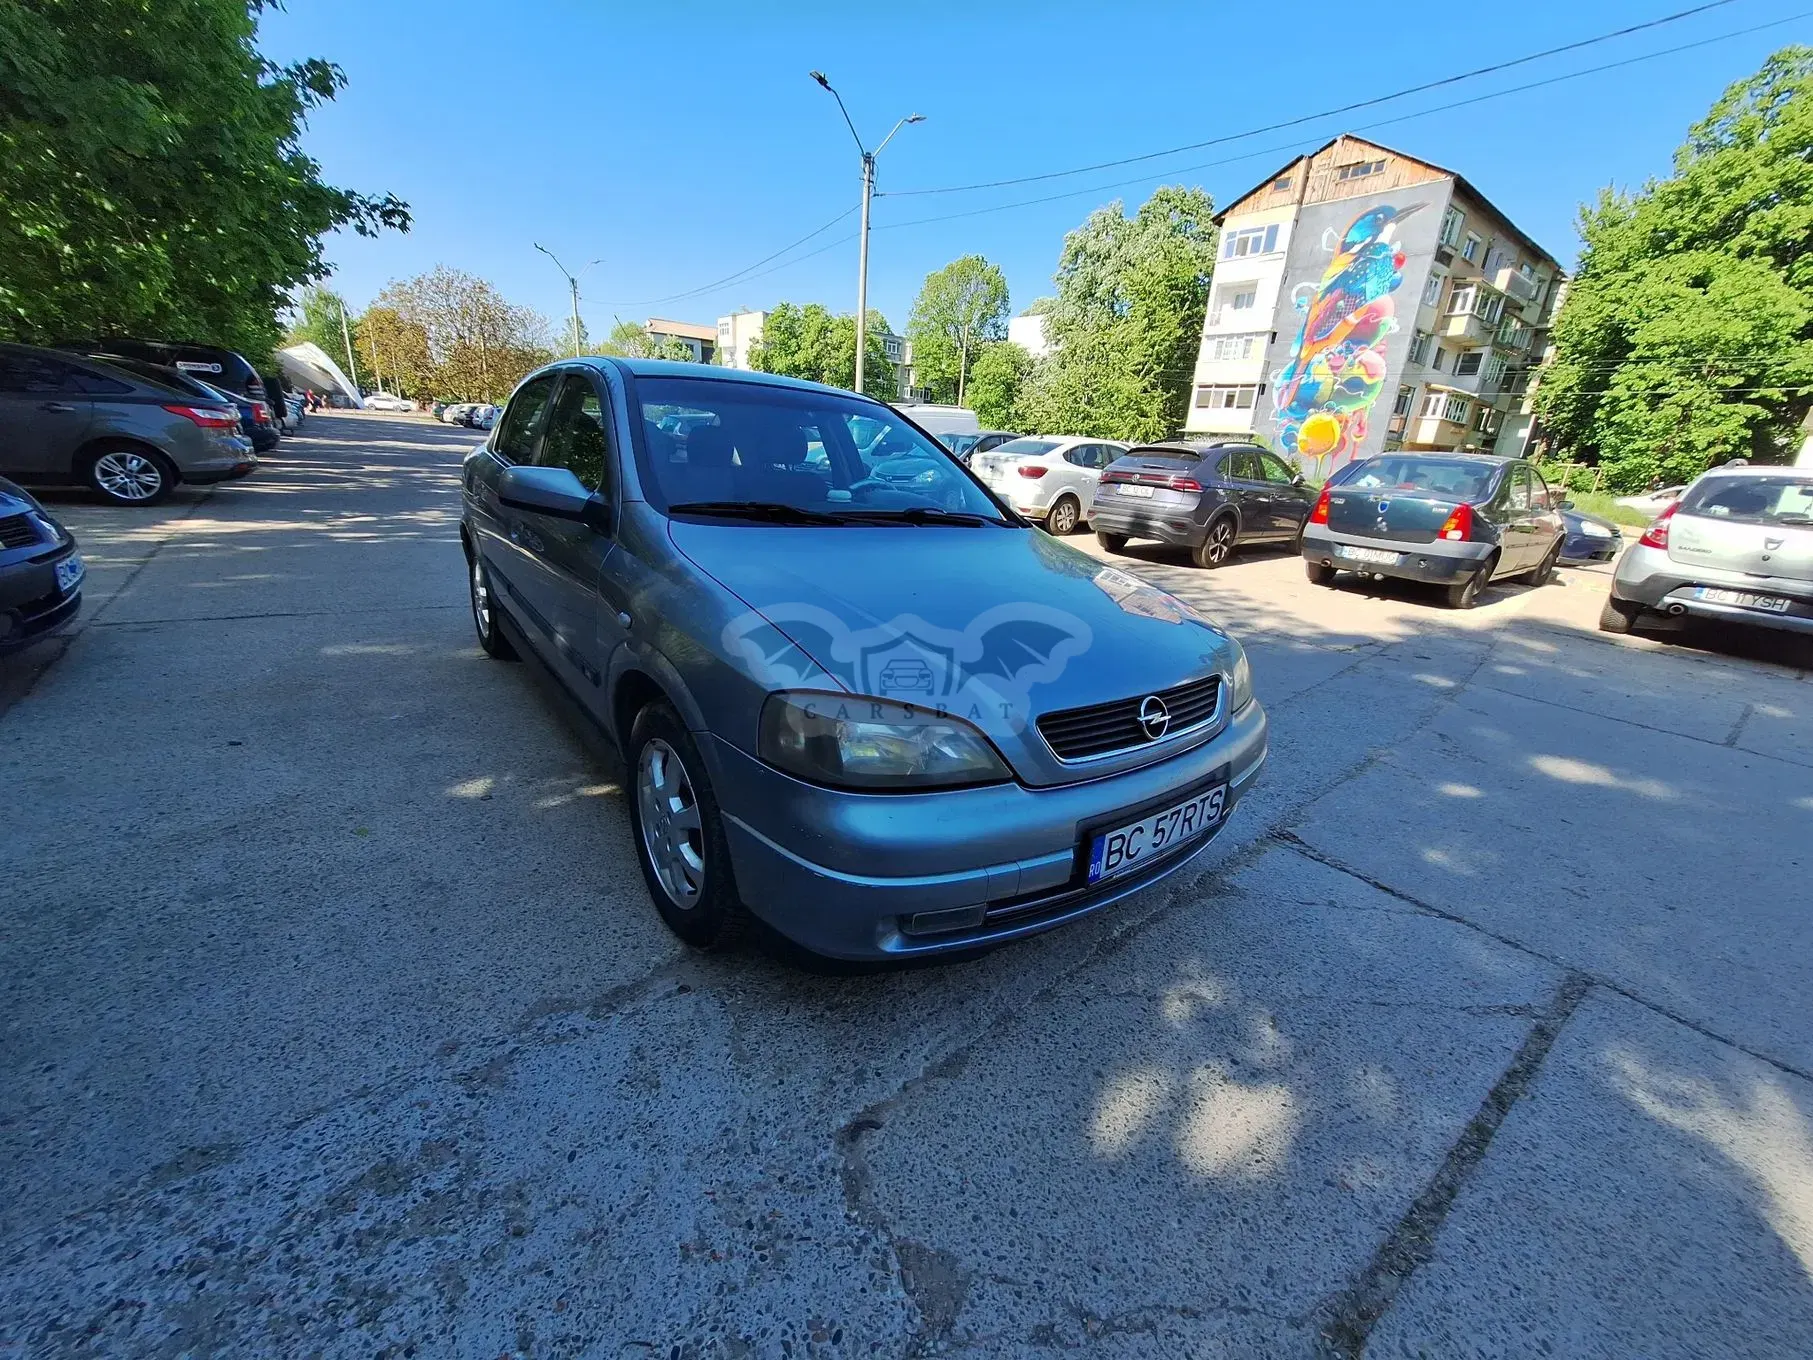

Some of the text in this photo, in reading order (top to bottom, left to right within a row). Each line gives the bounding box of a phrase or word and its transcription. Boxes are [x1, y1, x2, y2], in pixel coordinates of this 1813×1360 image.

[1705, 588, 1729, 601] BC
[1104, 789, 1223, 871] BC 57RTS
[1088, 861, 1101, 878] RO
